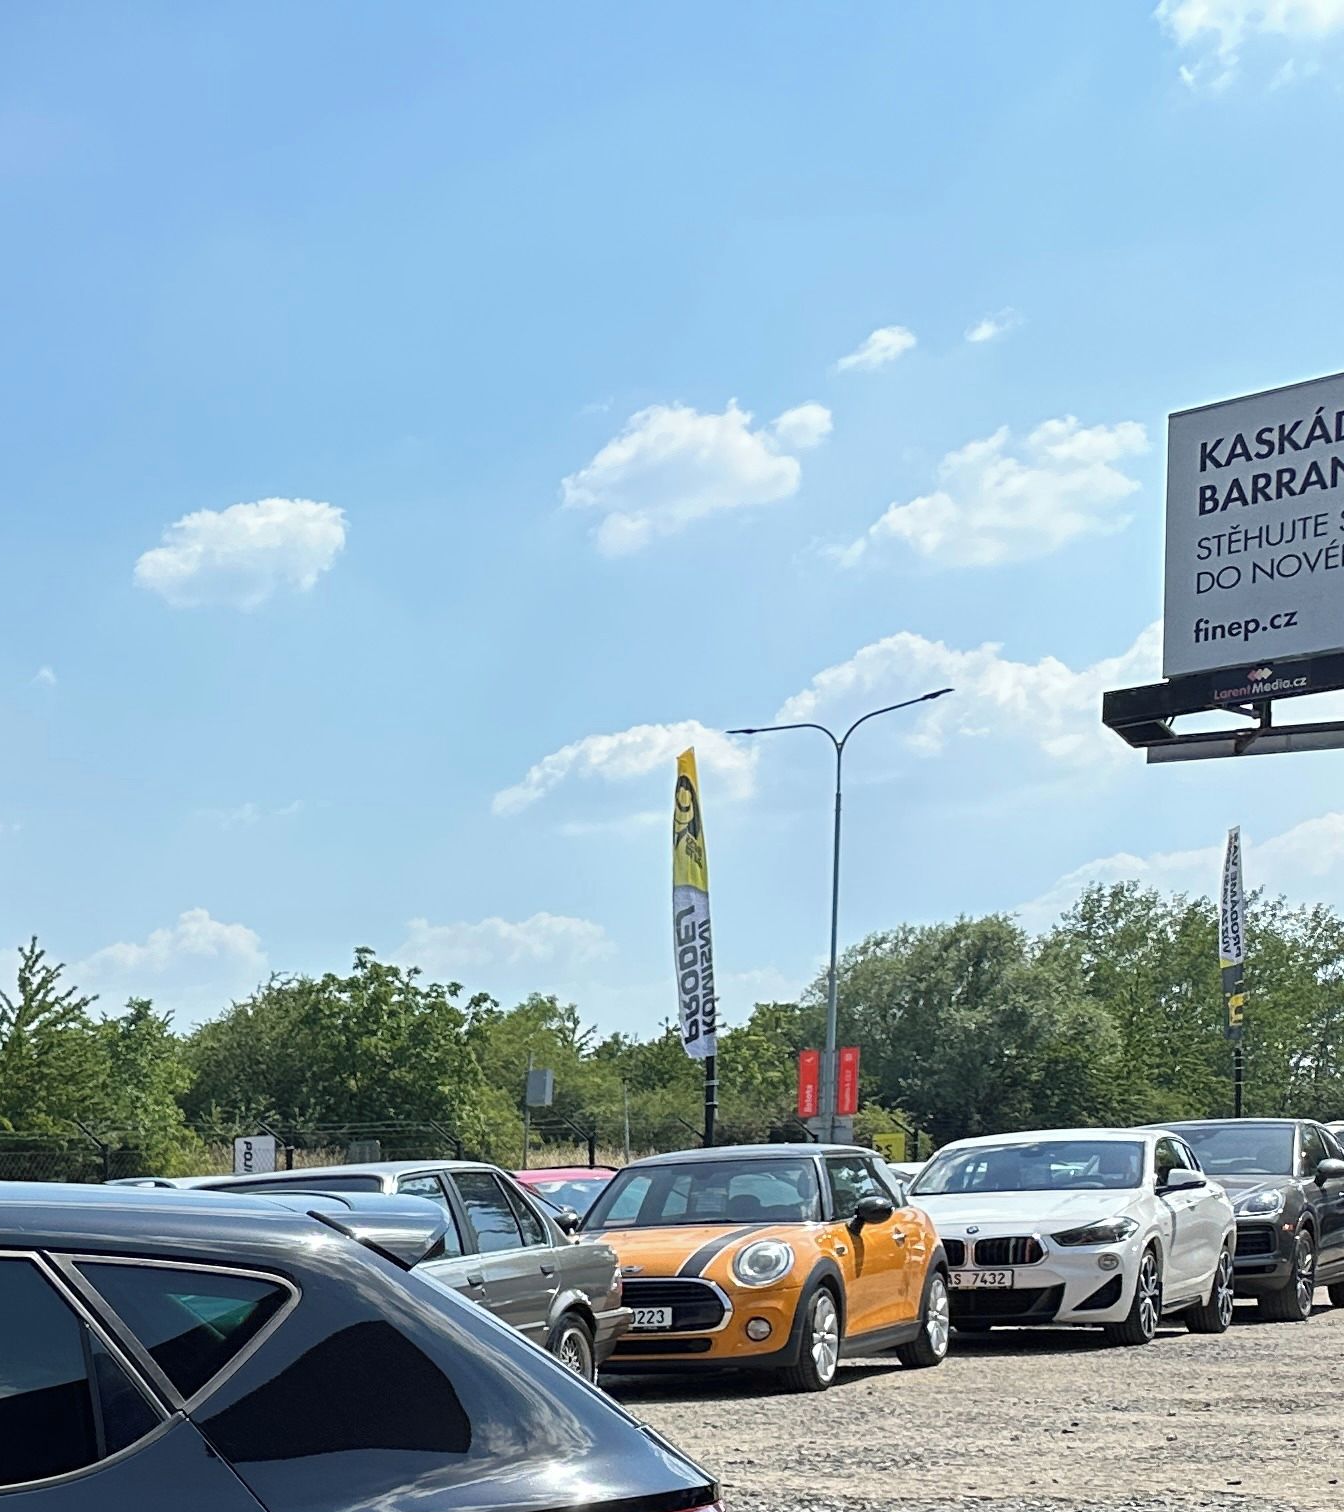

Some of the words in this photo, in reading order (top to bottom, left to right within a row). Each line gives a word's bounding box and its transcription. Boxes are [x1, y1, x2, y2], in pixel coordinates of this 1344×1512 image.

[1196, 512, 1329, 561] STĚHUJTE
[1196, 565, 1242, 595] DO
[1251, 538, 1344, 584] NOVÉ
[1194, 610, 1298, 643] finep.cz
[972, 1272, 1006, 1286] 7432
